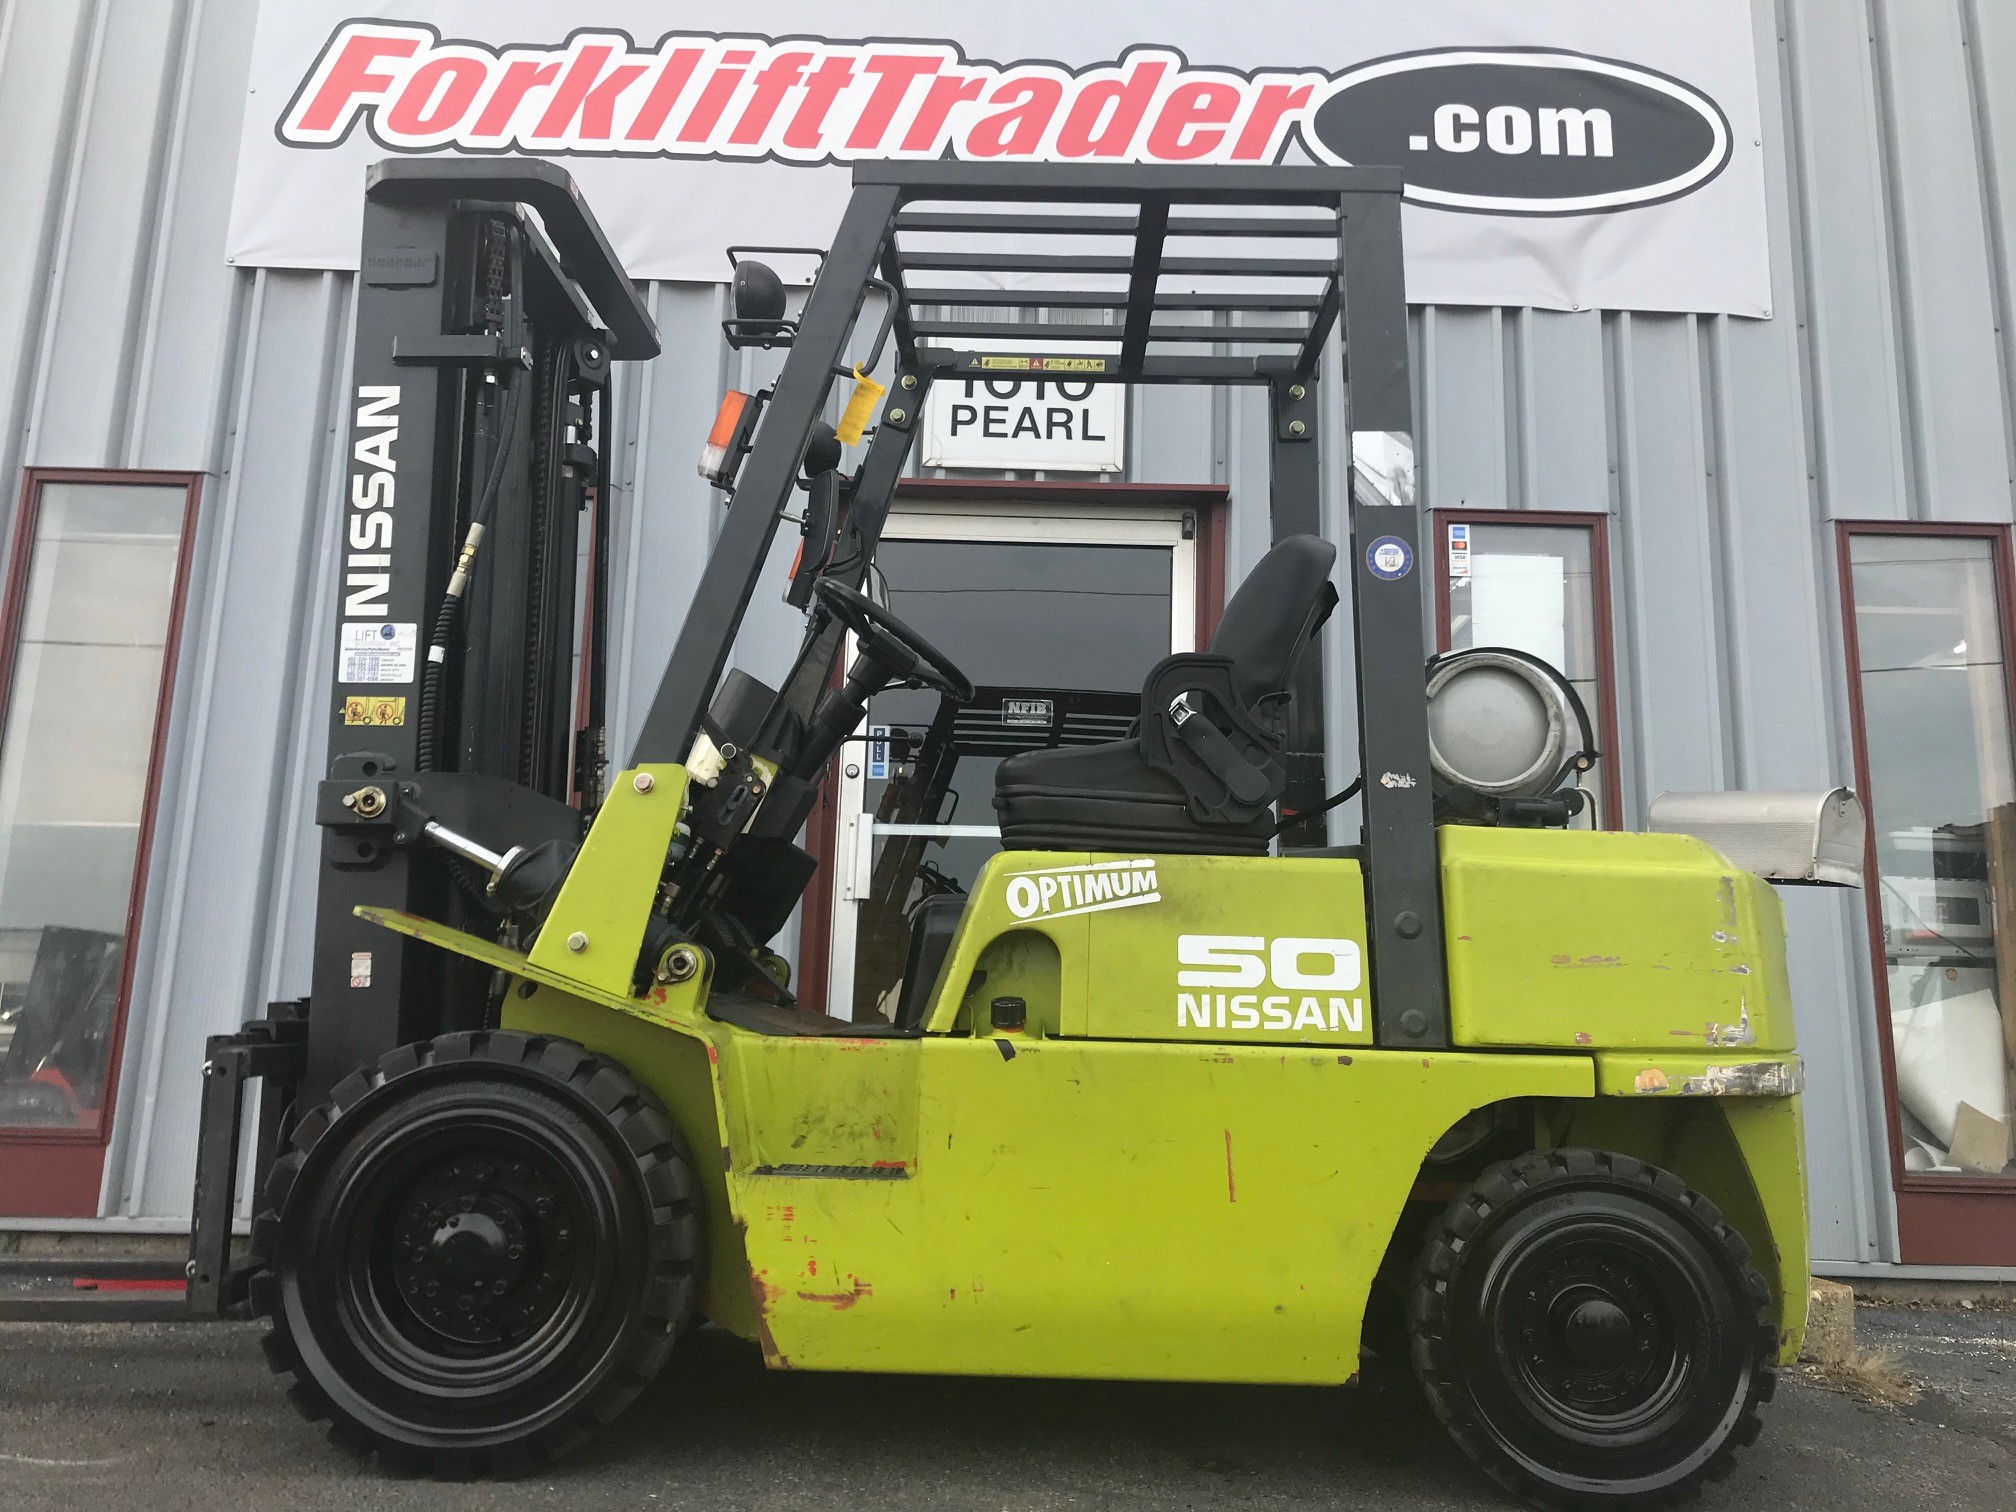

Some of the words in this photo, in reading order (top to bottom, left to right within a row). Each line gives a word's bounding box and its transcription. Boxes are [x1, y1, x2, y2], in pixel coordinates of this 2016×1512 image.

[950, 403, 1106, 442] PEARL
[344, 385, 401, 617] NISSAN
[355, 629, 378, 641] LIFT
[1007, 701, 1047, 715] NFIB
[1005, 869, 1159, 919] OPTIMUM
[1176, 933, 1362, 991] 50
[1176, 992, 1364, 1032] NISSAN
